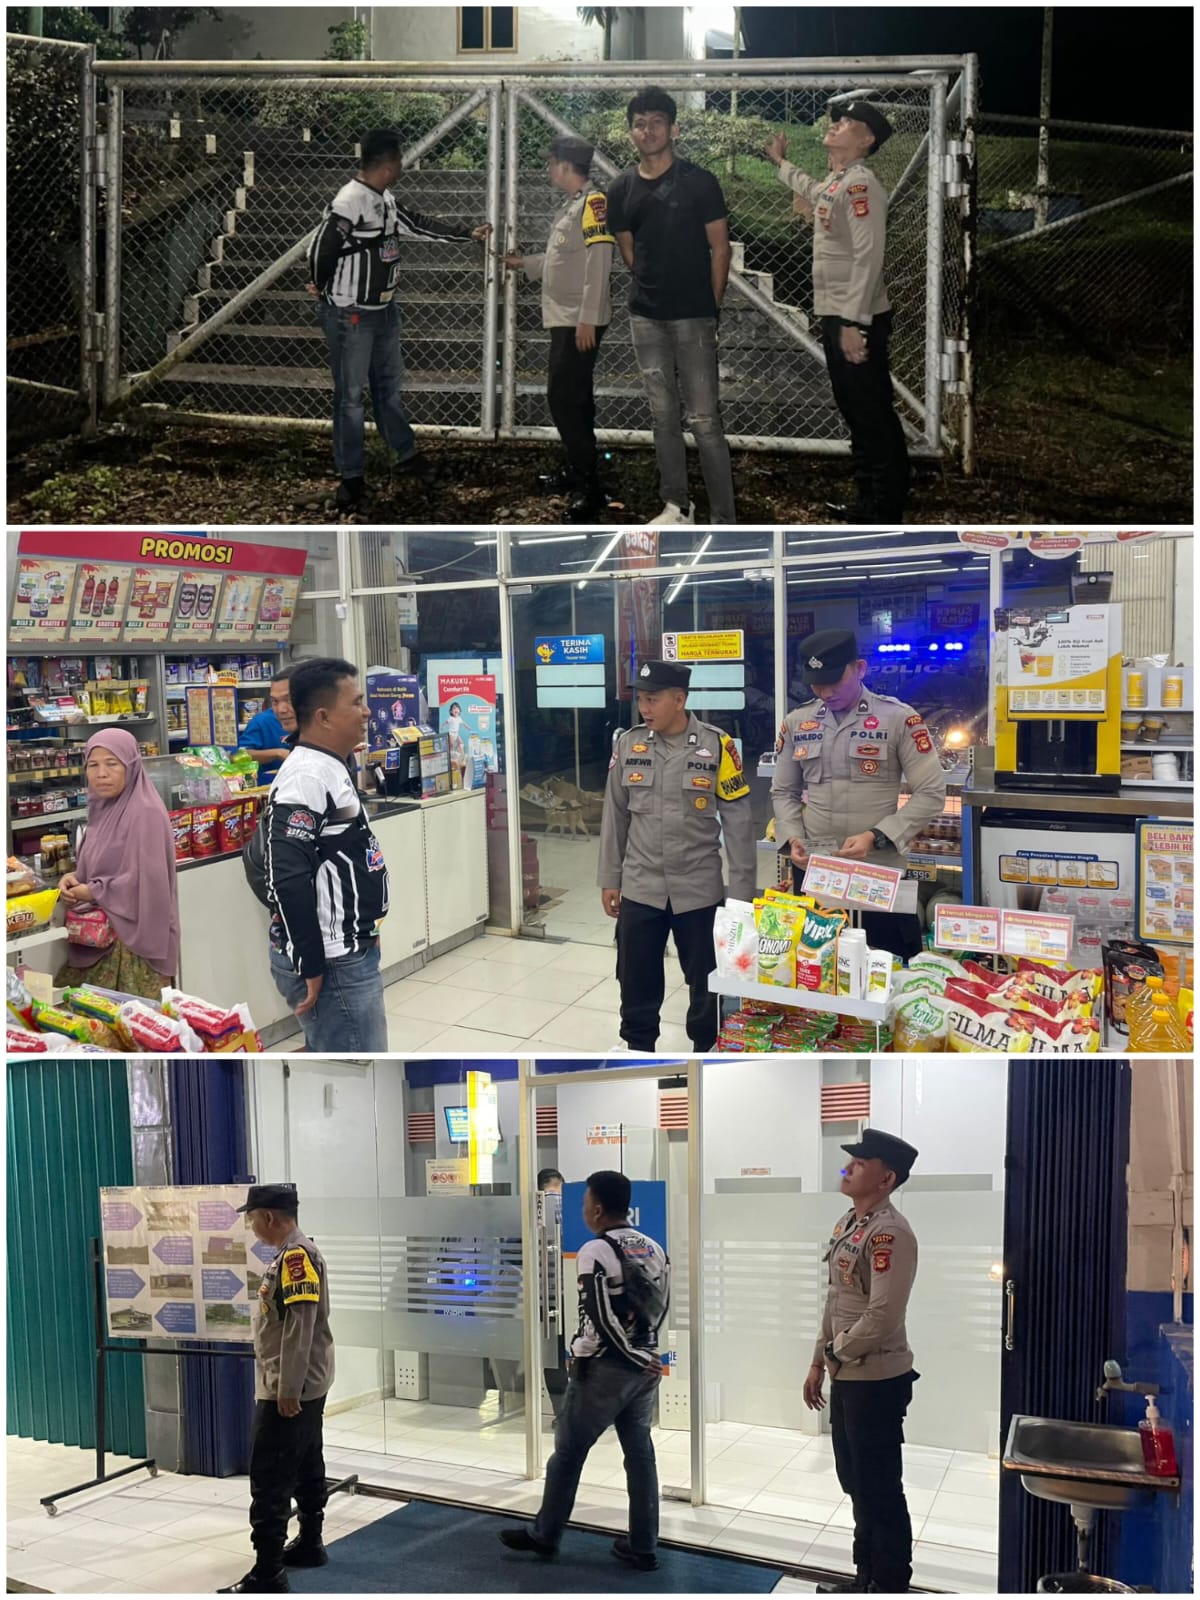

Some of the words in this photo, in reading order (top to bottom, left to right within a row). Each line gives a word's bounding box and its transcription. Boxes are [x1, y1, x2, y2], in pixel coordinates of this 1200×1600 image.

[140, 536, 234, 564] PROMOSI
[560, 639, 592, 647] TERIMA
[563, 646, 589, 654] KASIH
[850, 730, 888, 740] POLRI
[687, 761, 718, 772] POLRI
[1146, 832, 1167, 841] BELI
[1154, 842, 1180, 850] LEBIH
